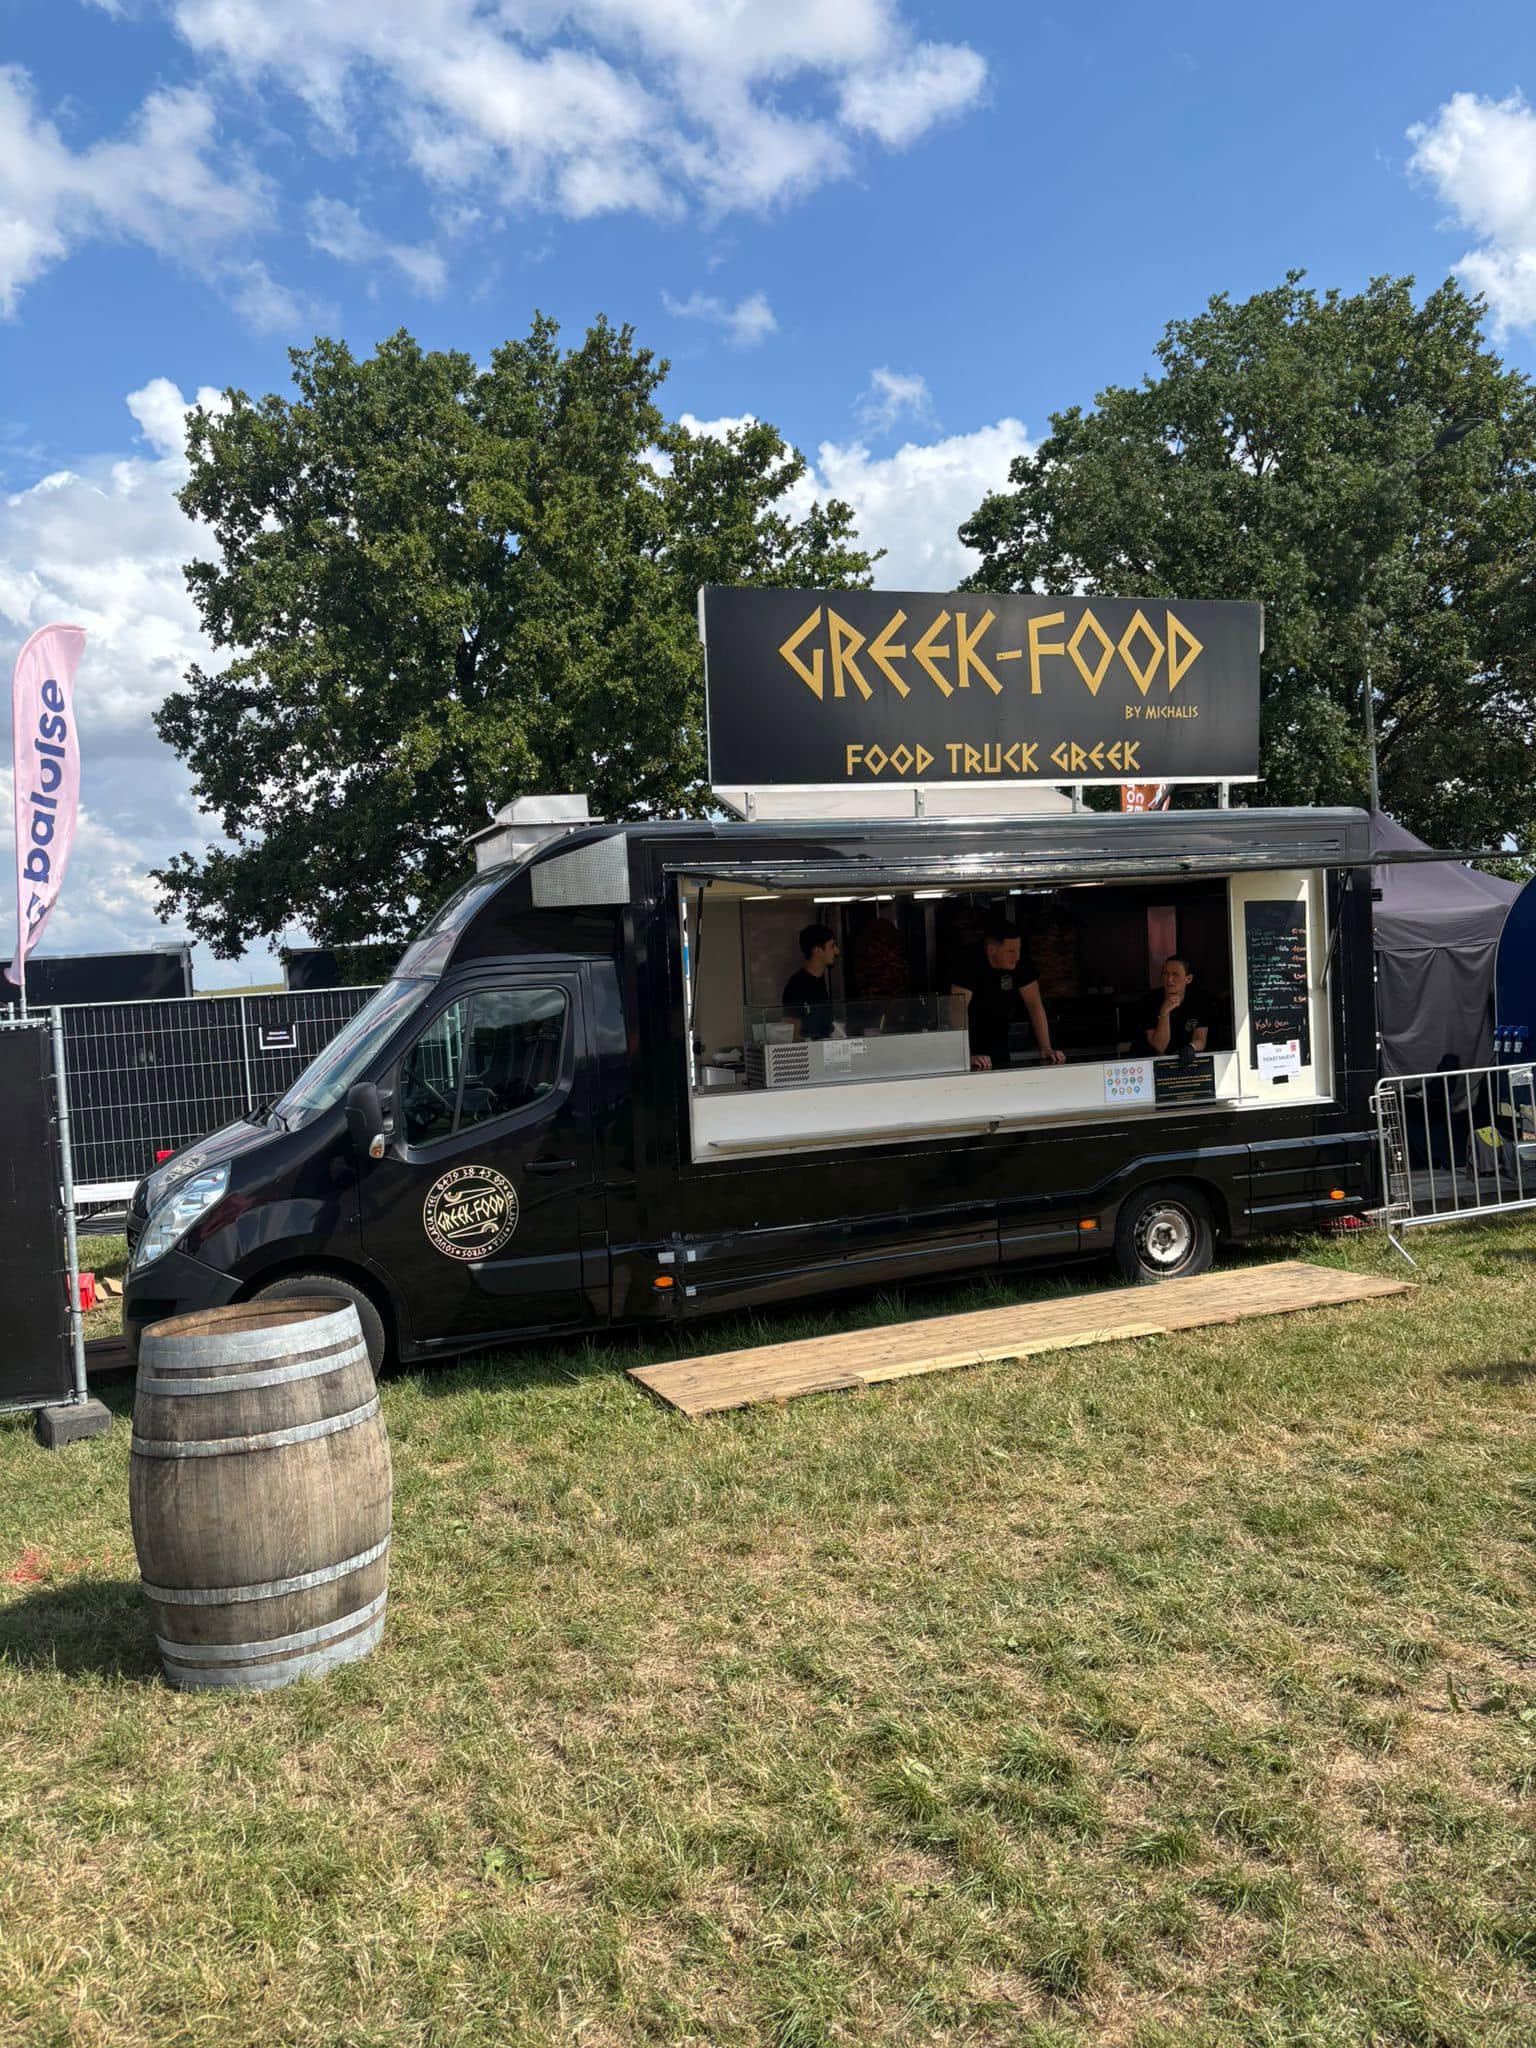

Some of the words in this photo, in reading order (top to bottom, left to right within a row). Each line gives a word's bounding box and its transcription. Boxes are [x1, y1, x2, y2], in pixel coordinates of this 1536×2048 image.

[778, 604, 1204, 701] GREEK-FOOD
[1125, 704, 1141, 720] BY
[1145, 704, 1199, 720] MICHALIS
[846, 743, 935, 776] FOOD
[945, 742, 1039, 774] TRUCK
[1050, 741, 1141, 772] GREEK
[23, 678, 67, 883] baloise
[437, 1171, 459, 1190] 0479
[478, 1168, 491, 1178] 45
[438, 1194, 504, 1232] GREEK-FOOD
[462, 1246, 487, 1257] GYROS
